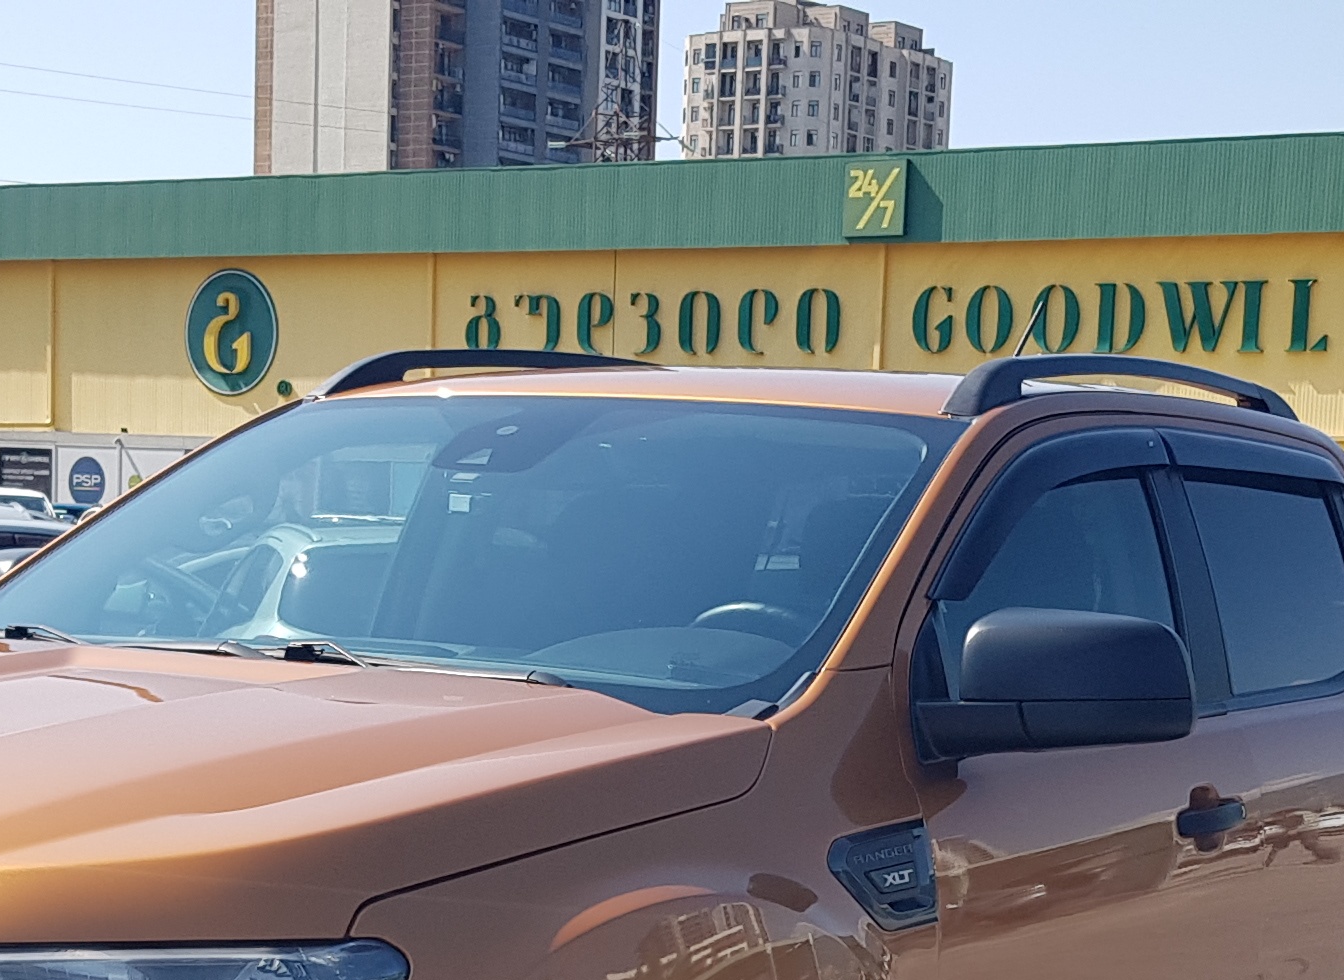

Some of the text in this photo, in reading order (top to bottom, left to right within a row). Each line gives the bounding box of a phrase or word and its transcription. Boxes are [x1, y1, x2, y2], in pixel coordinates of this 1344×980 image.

[848, 167, 901, 231] 24/7
[72, 474, 101, 487] PSP
[852, 844, 914, 866] RANGER
[883, 868, 914, 888] XLT
